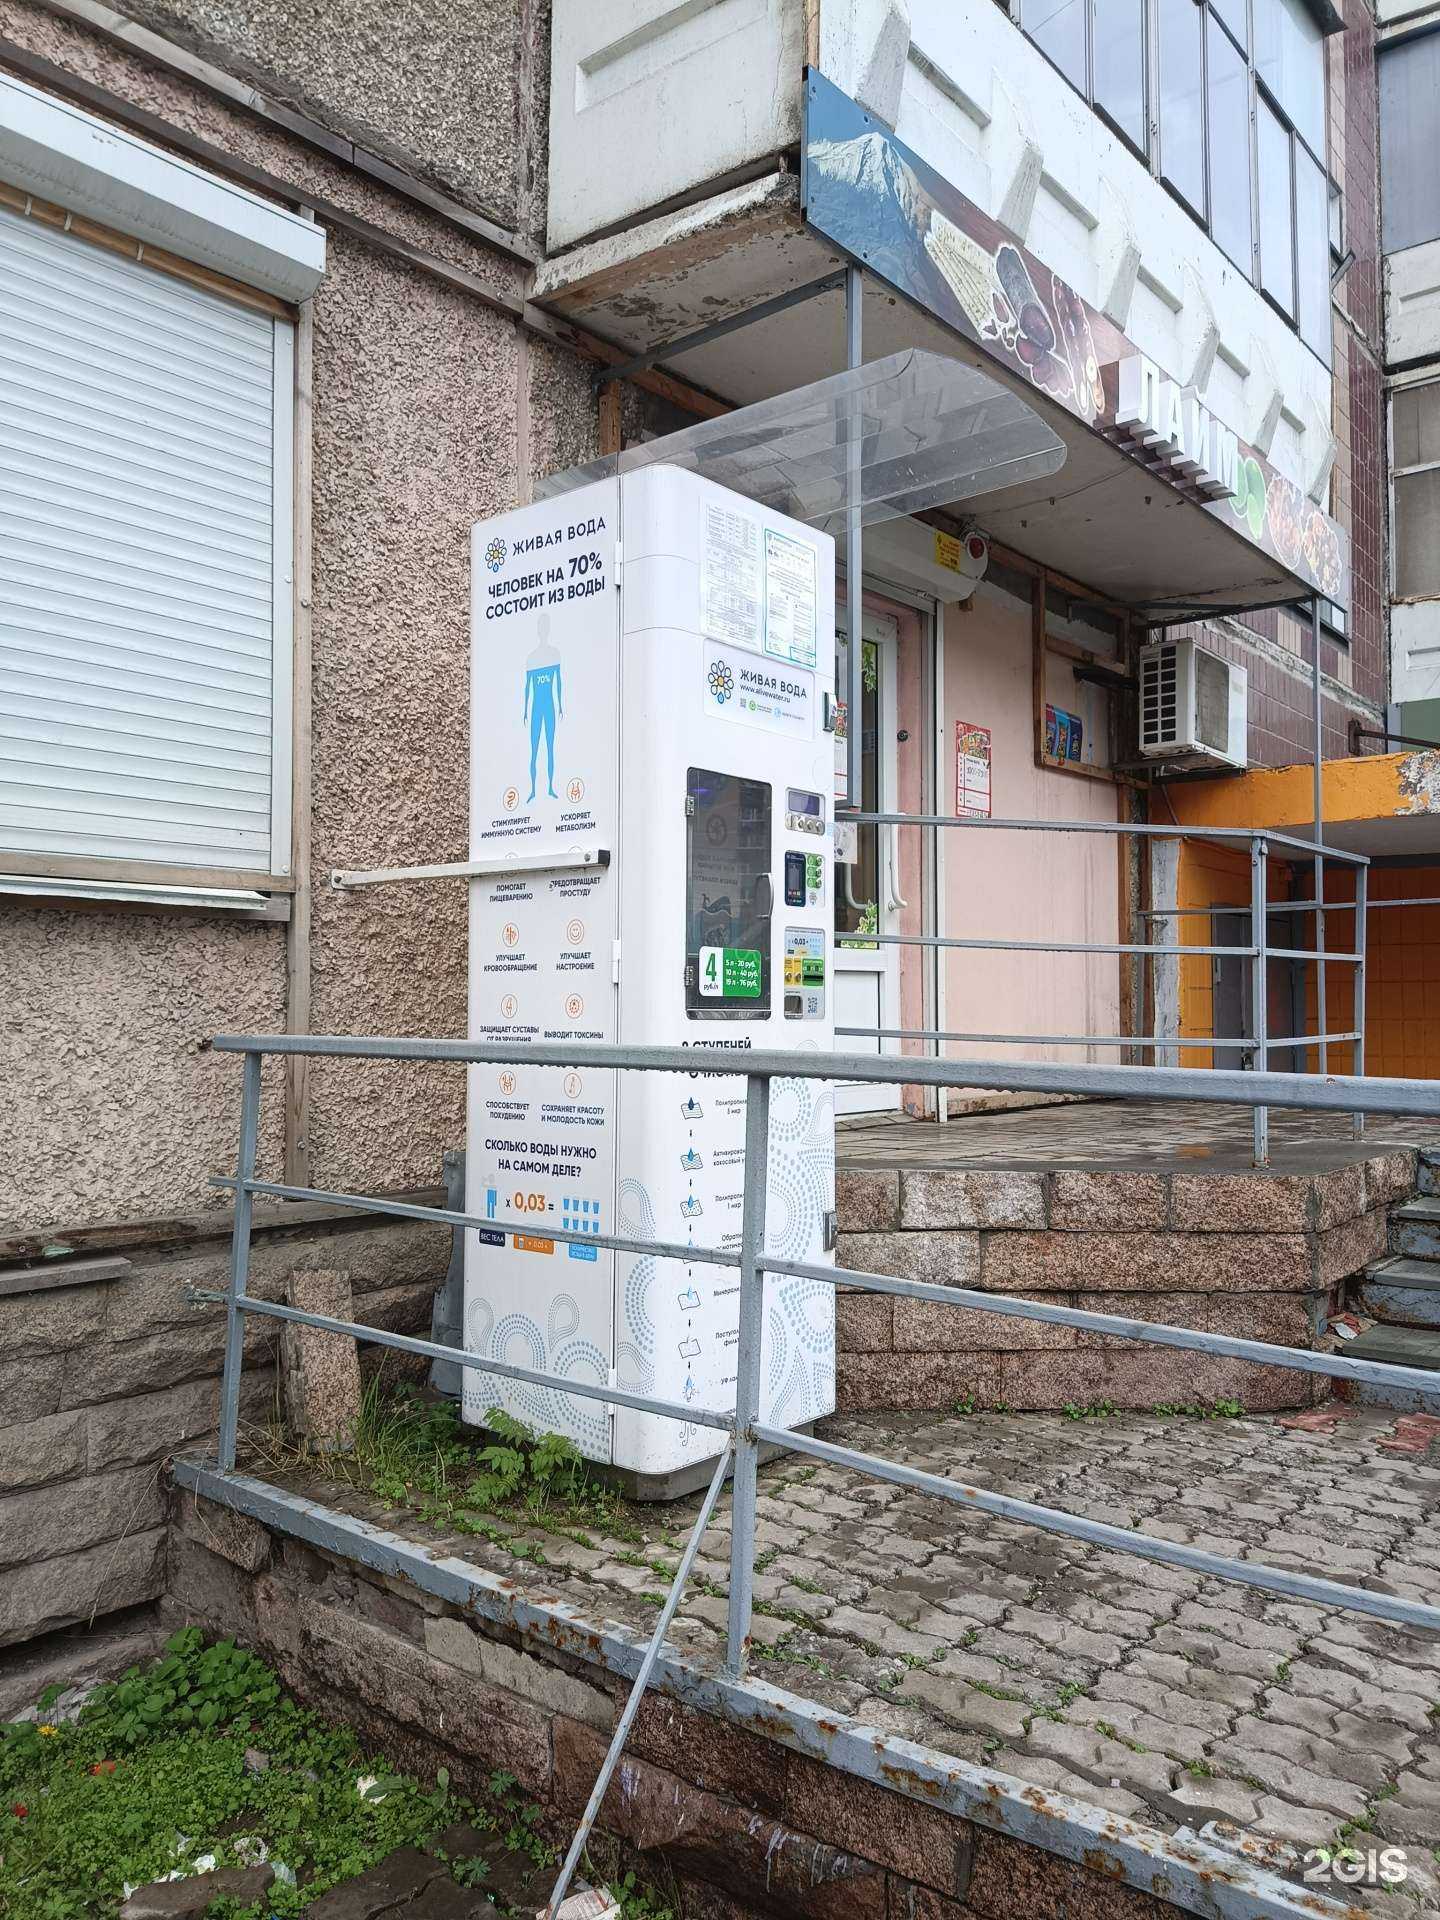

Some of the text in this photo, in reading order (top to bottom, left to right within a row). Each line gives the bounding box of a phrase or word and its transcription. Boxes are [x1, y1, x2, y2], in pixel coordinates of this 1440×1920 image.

[512, 517, 606, 556] ЖИВАЯ ВОДА
[488, 552, 602, 598] ЧЕЛОВЕК НА 70%
[486, 576, 606, 620] СОСТОИТ ИЗ ВОДЫ
[740, 668, 807, 699] ЖИВАЯ ВОДА
[492, 816, 531, 828] СТИМУЛИРУЕТ
[560, 812, 591, 822] УСКОРЯЕТ
[556, 822, 596, 832] МЕТАБОЛИЗМ
[480, 826, 542, 839] ИММУННУЮ СИСТЕМУ
[496, 882, 526, 892] ПОМОГАЕТ
[489, 892, 533, 902] ПИЩЕВАРЕНИЮ
[560, 888, 591, 897] ПРОСТУДУ
[484, 964, 538, 972] КРОВООБРАЩЕНИЕ
[556, 962, 594, 970] НАСТРОЕНИЕ
[705, 953, 717, 982] 4
[544, 1031, 573, 1039] ВЫВОДИТ
[486, 1101, 529, 1110] СПОСОБСТВУЕТ
[541, 1104, 604, 1115] СОХРАНЯЕТ КРАСОТУ
[490, 1112, 526, 1121] ПОХУДЕНИЮ
[547, 1116, 585, 1124] МОЛОДОСТЬ
[485, 1139, 597, 1159] СКОЛЬКО ВОДЫ НУЖНО
[498, 1159, 582, 1177] НА САМОМ ДЕЛЕ?
[514, 1192, 545, 1212] 0,03
[481, 1233, 491, 1241] ВЕС
